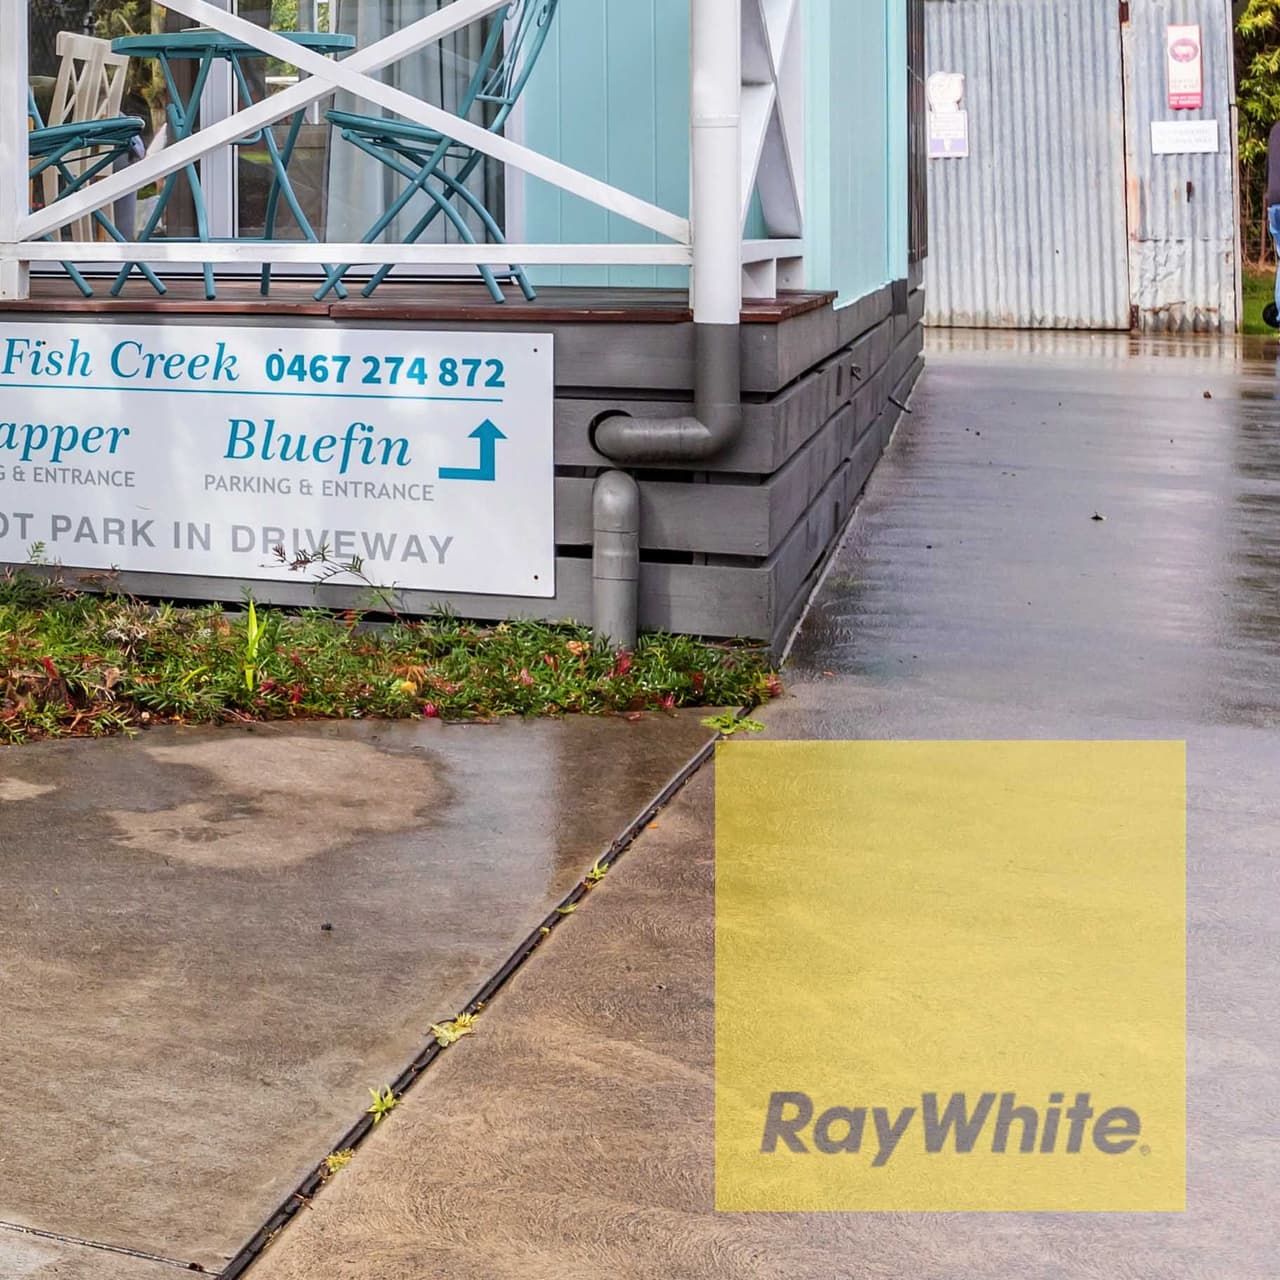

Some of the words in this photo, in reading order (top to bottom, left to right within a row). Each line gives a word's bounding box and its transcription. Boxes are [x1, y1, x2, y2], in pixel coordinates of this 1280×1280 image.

[1, 338, 93, 377] Fish
[110, 340, 240, 382] Creek
[265, 353, 351, 384] 0467
[362, 356, 428, 386] 274
[438, 358, 506, 388] 872
[223, 418, 412, 475] Bluefin
[12, 466, 26, 483] &
[33, 466, 136, 488] ENTRANCE
[204, 474, 291, 495] PARKING
[299, 479, 313, 496] &
[322, 480, 434, 502] ENTRANCE
[51, 514, 157, 548] PARK
[173, 521, 212, 551] IN
[231, 524, 454, 564] DRIVEWAY
